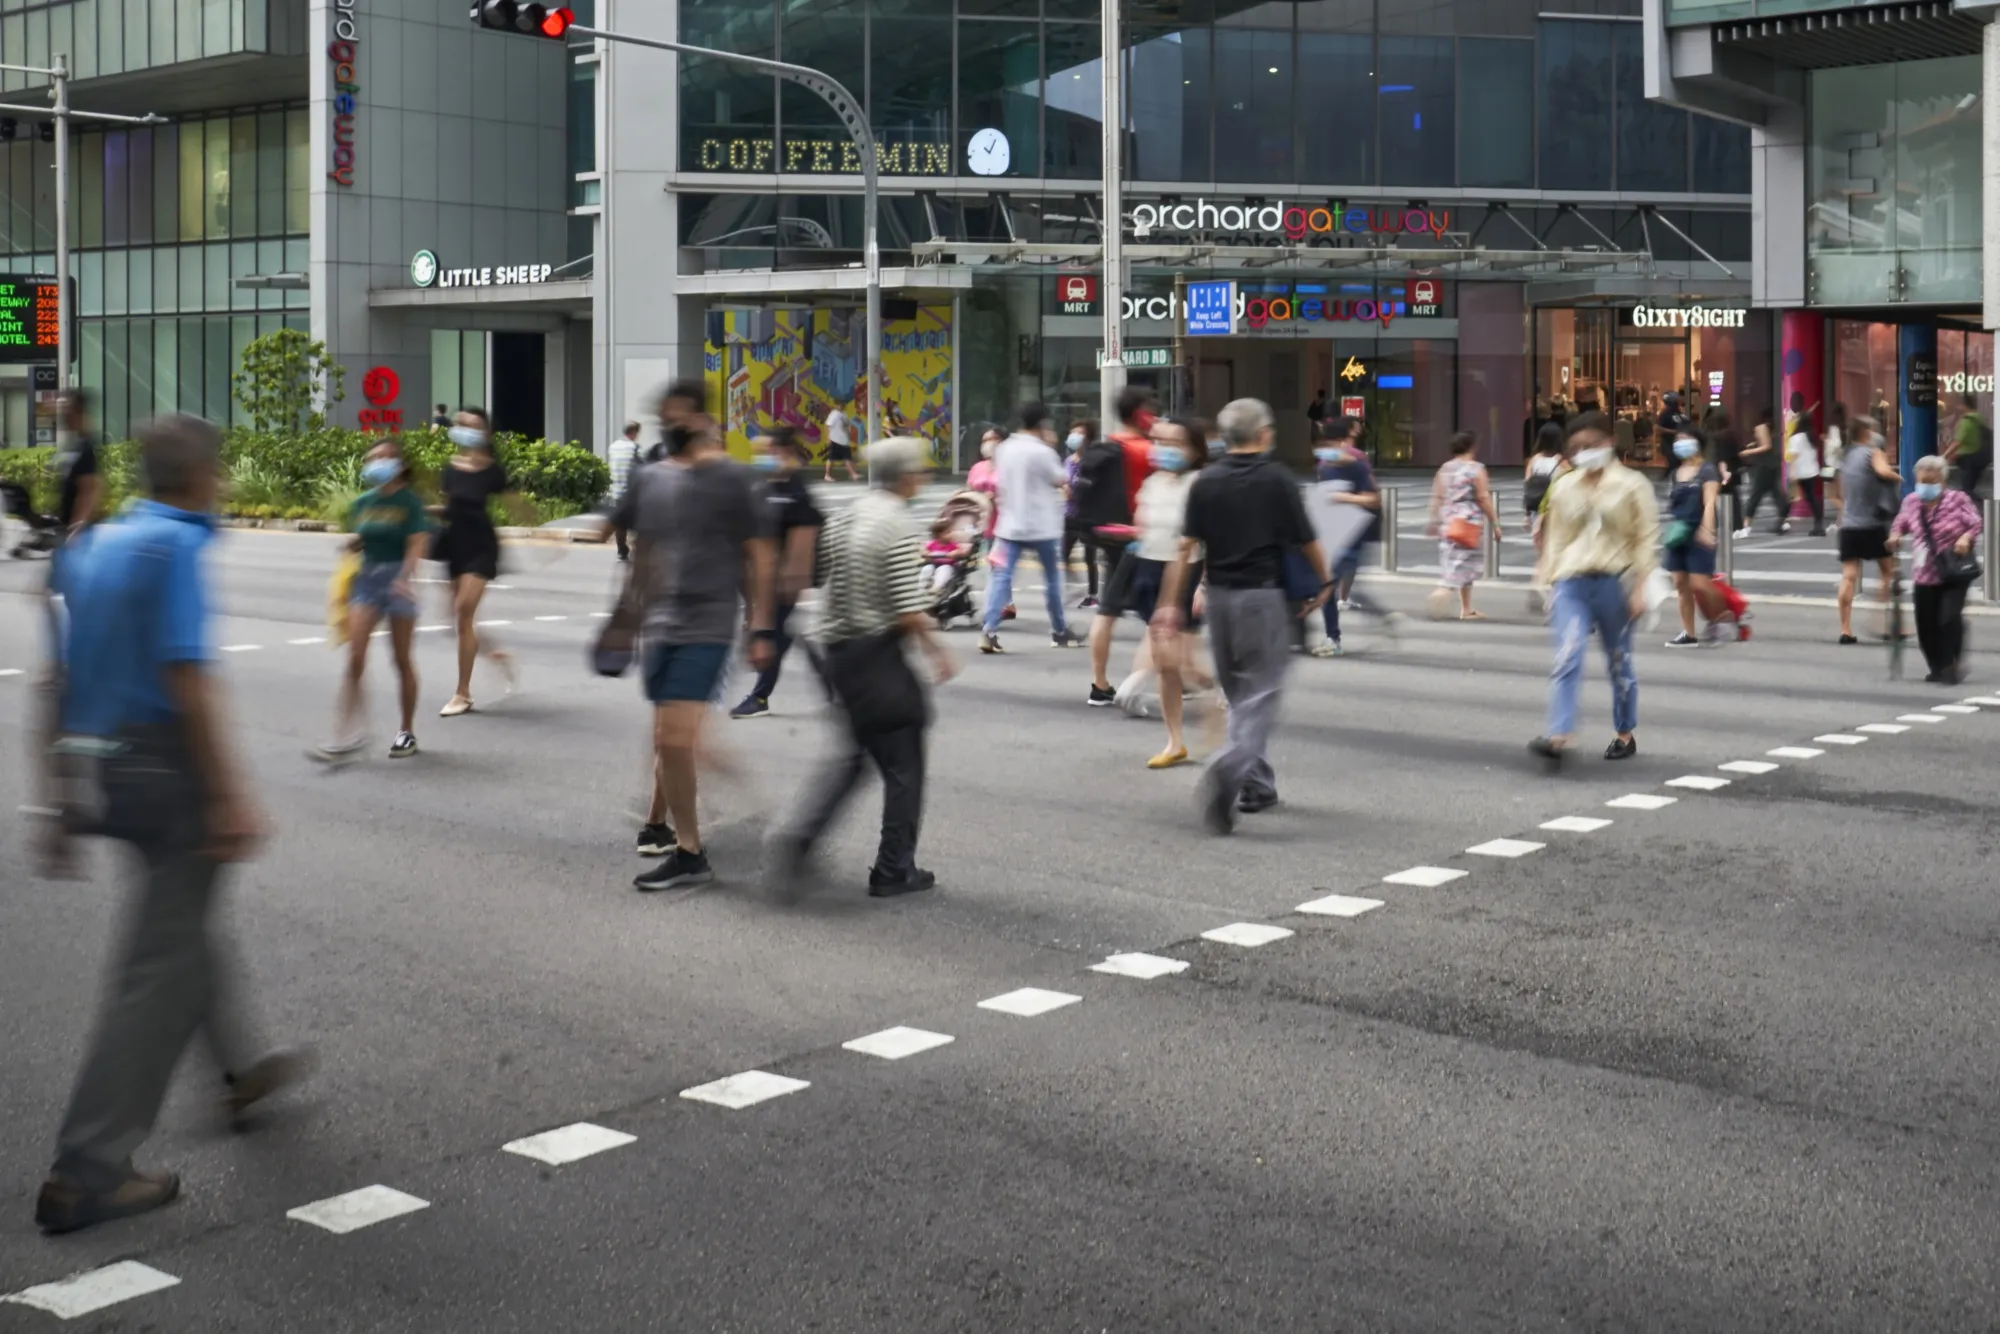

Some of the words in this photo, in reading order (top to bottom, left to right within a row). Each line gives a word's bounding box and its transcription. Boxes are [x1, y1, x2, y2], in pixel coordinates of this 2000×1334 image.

[1133, 198, 1449, 241] orchardgateway
[439, 267, 491, 288] LITTLE
[495, 263, 552, 285] SHEEP
[1064, 302, 1090, 313] MRT
[1412, 304, 1437, 316] MRT
[1632, 304, 1747, 328] 6IXTY8IGHT
[1152, 349, 1167, 365] RD
